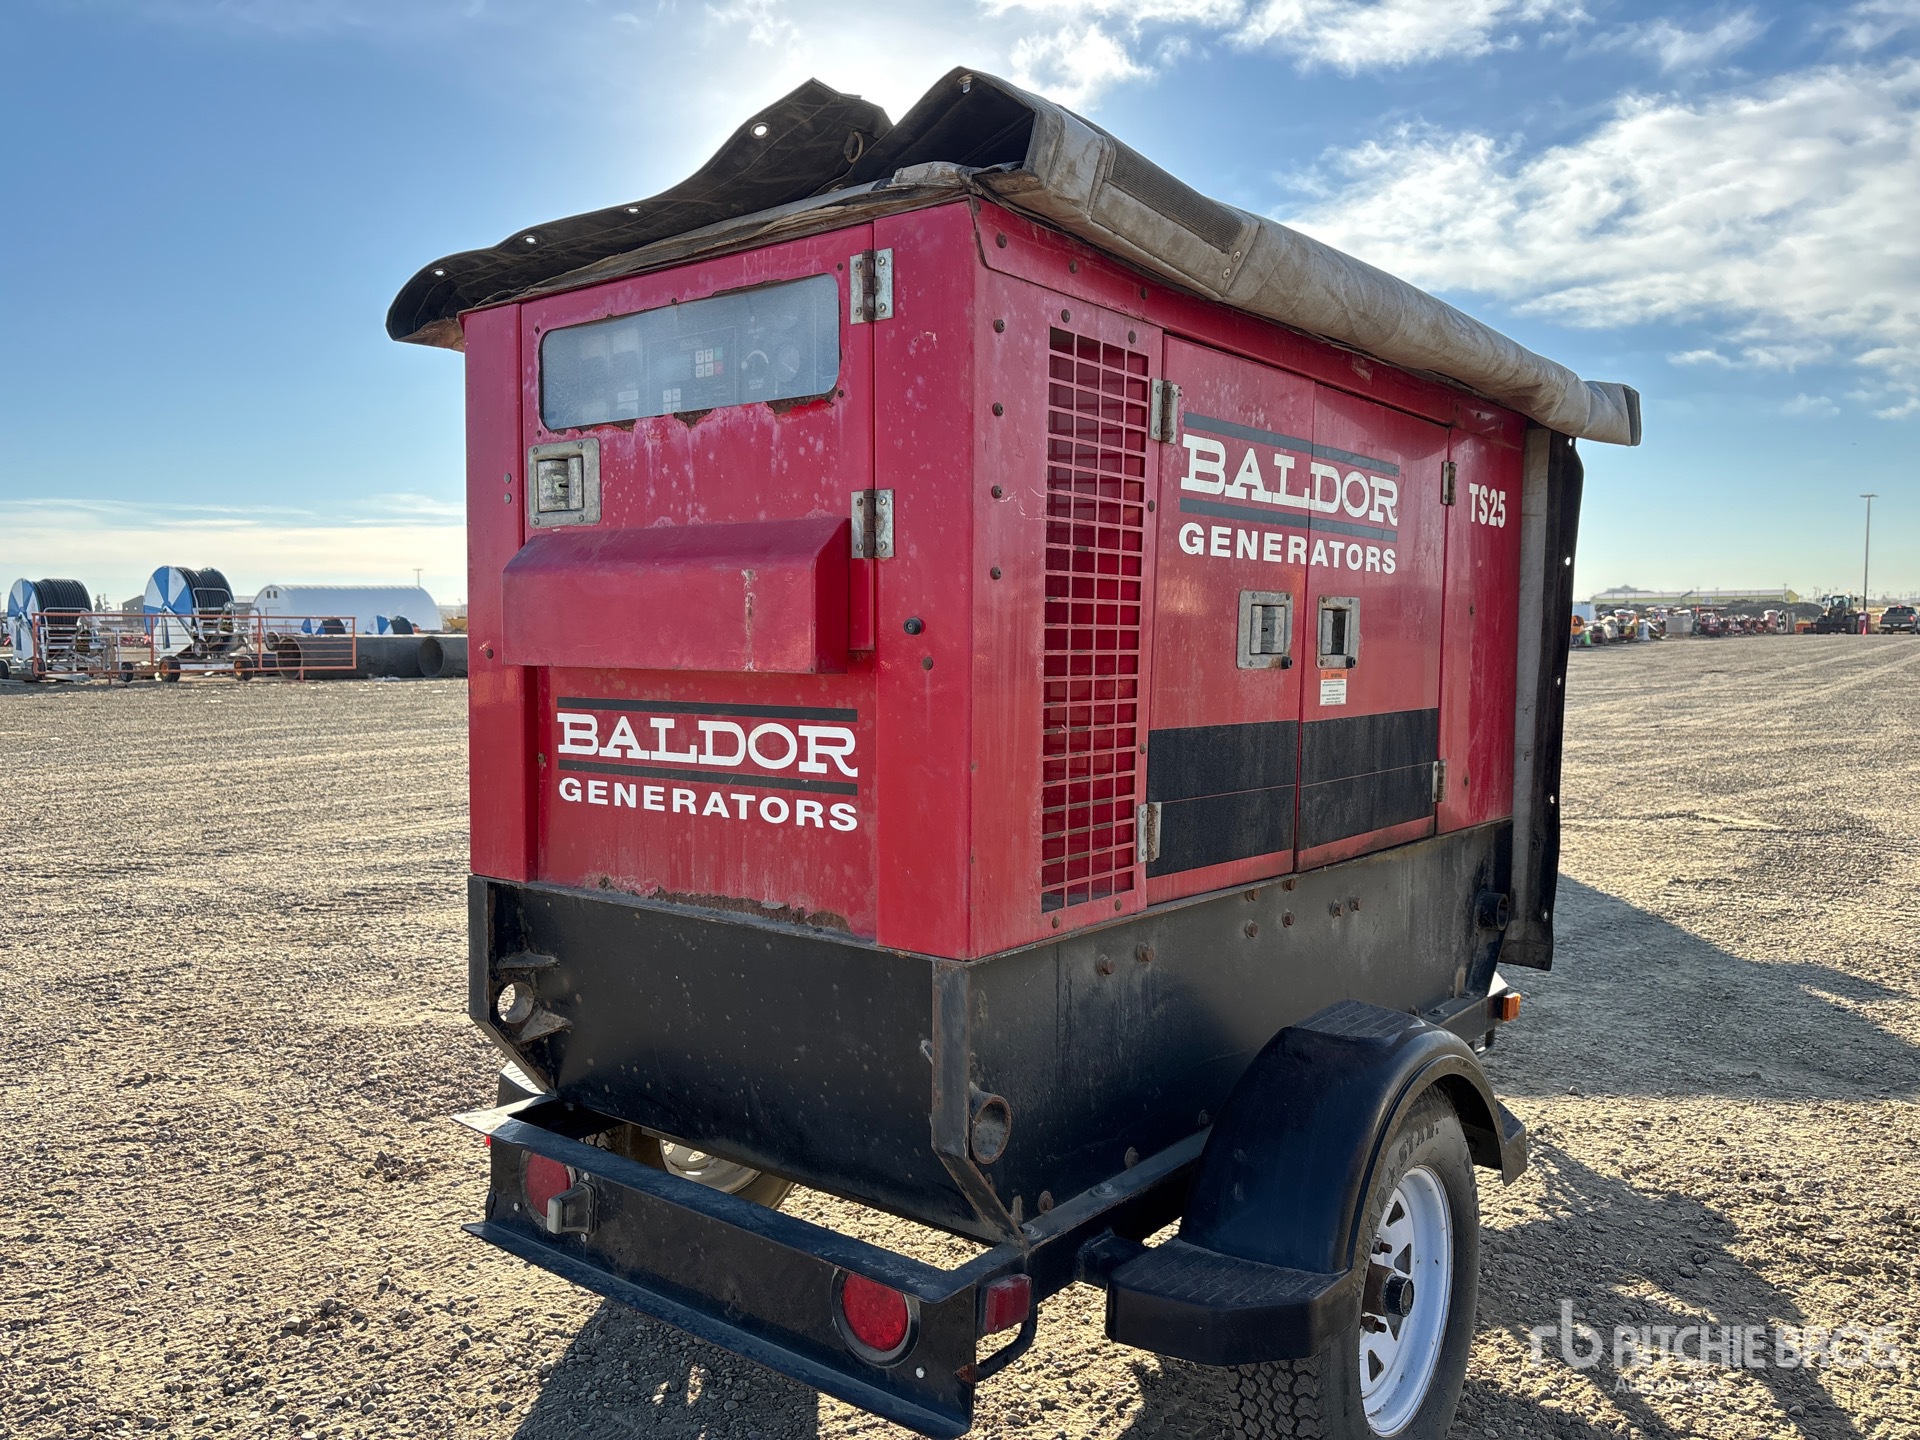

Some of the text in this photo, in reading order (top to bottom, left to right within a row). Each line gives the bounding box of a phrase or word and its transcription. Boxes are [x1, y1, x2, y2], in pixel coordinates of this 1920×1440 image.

[1181, 434, 1398, 526] BALDOR
[1469, 483, 1505, 528] TS25
[1178, 522, 1396, 574] GENERATORS
[557, 713, 858, 777] BALDOR
[558, 777, 858, 831] GENERATORS
